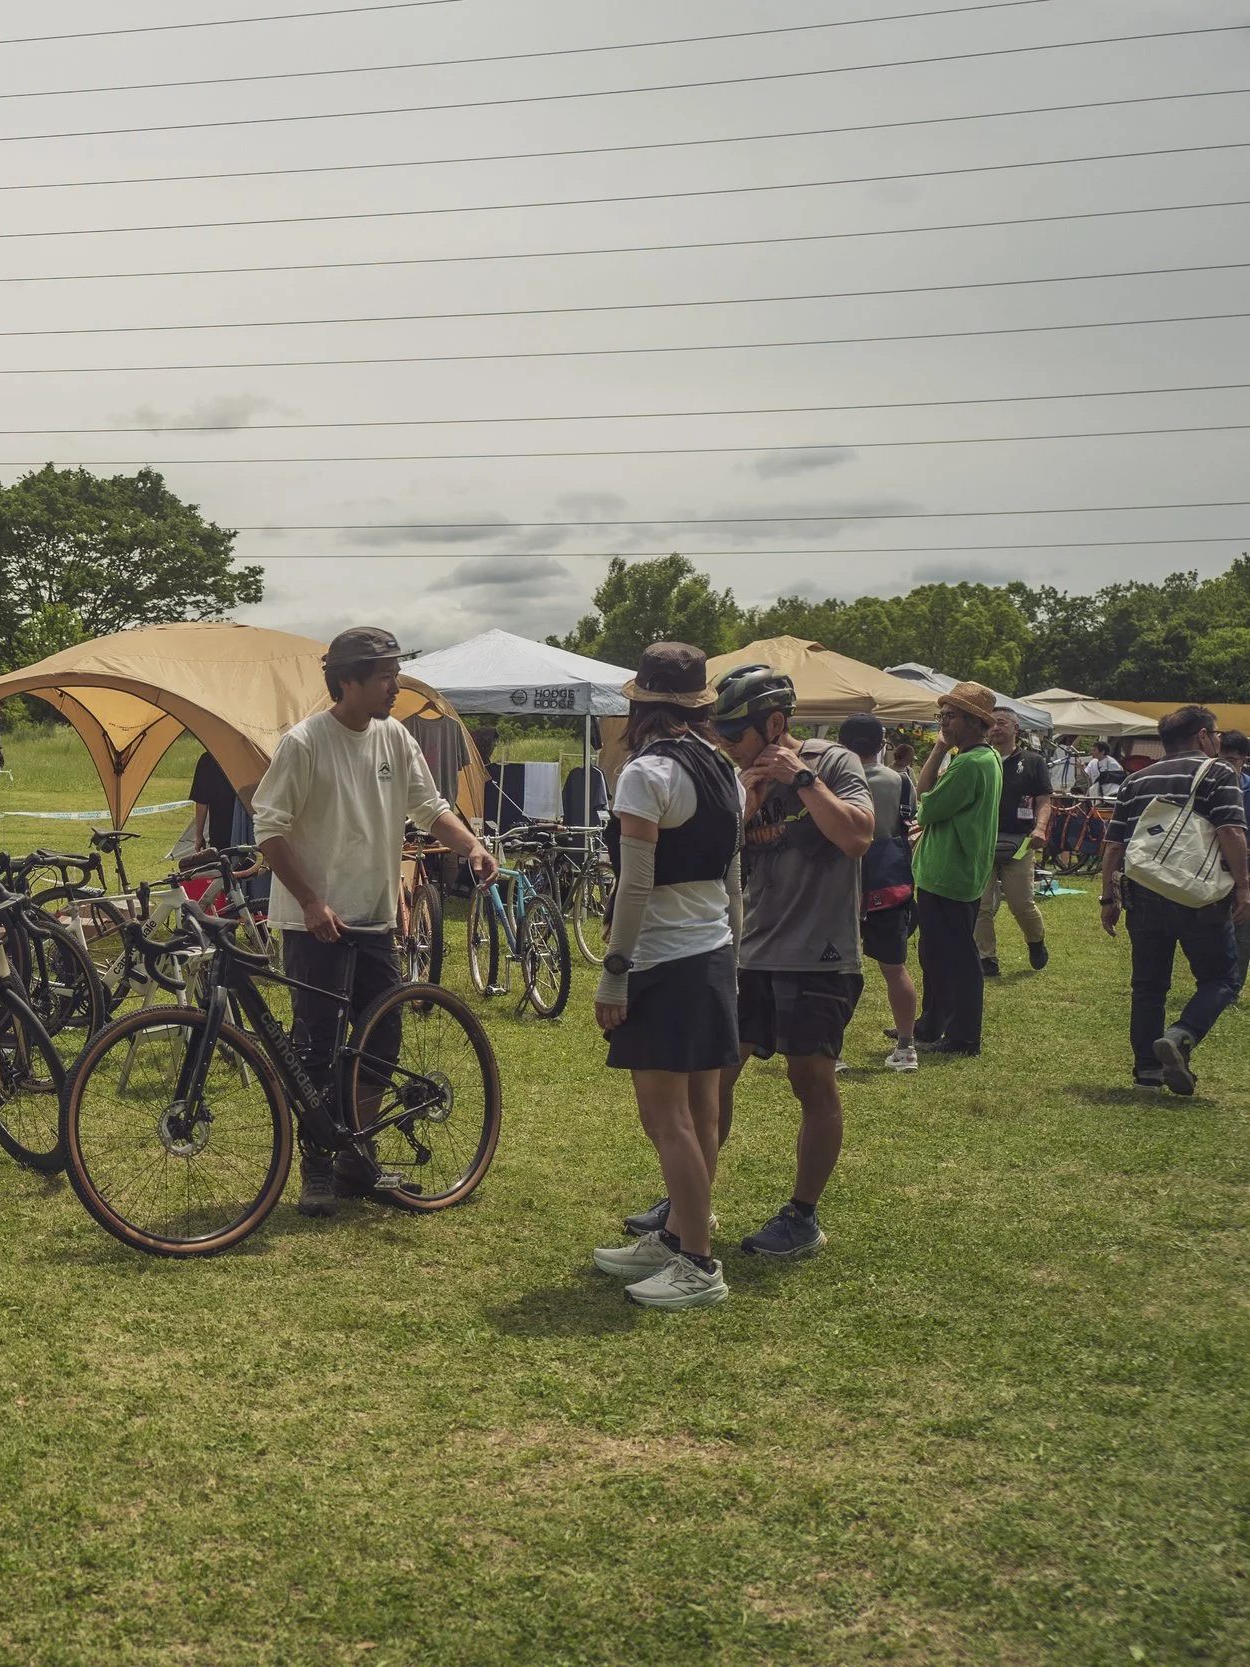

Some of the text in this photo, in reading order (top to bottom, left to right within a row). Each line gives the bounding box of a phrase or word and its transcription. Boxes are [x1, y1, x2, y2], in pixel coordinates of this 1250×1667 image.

[535, 688, 575, 699] HODGE
[534, 699, 574, 709] PODGE
[261, 1011, 321, 1110] cannondale
